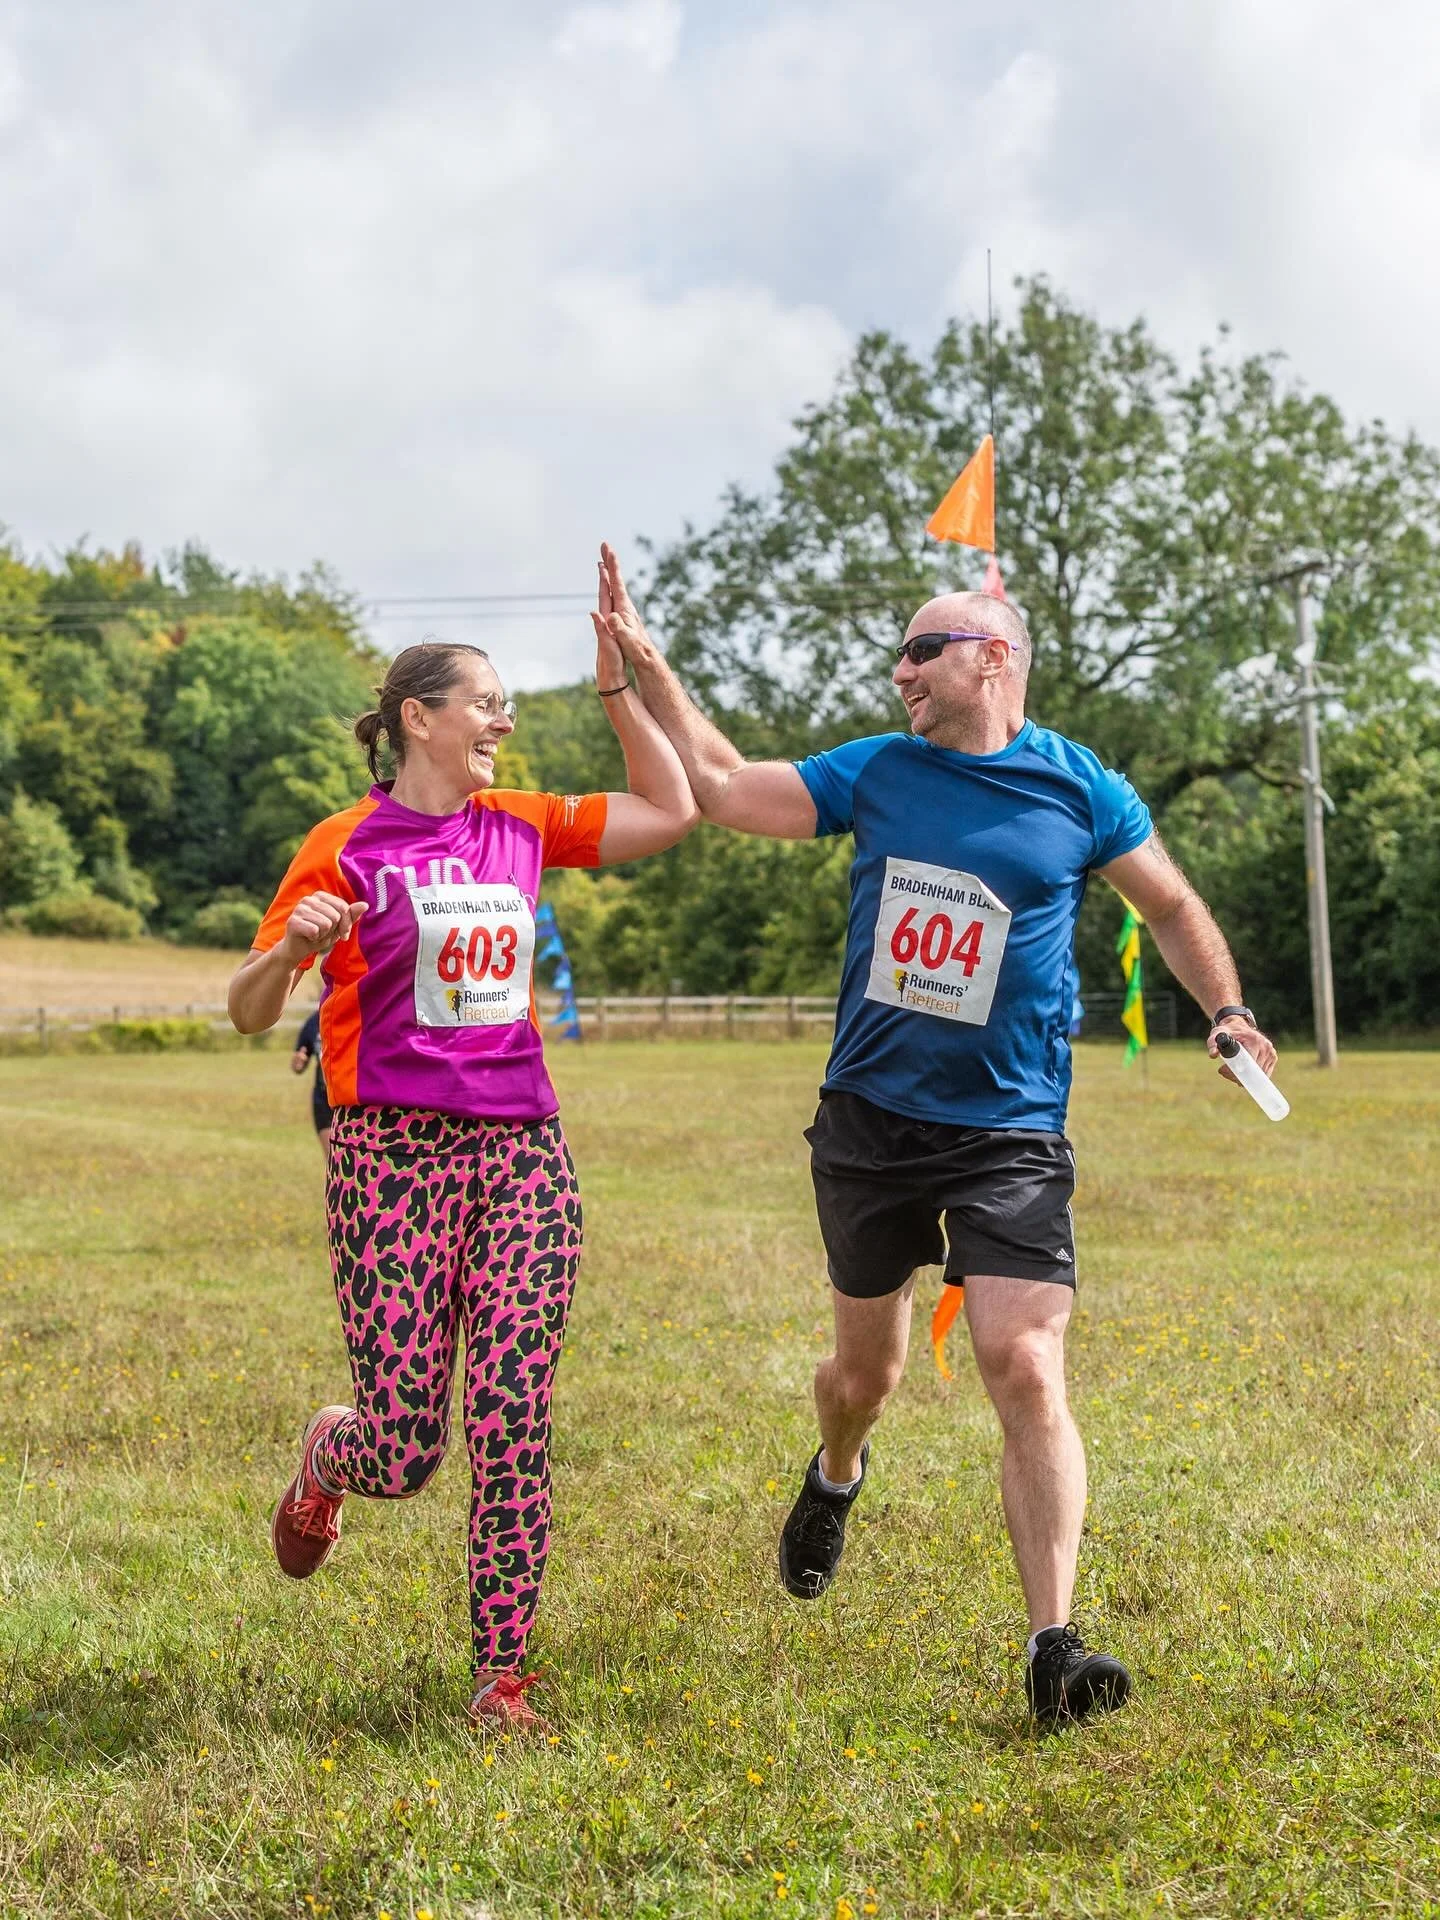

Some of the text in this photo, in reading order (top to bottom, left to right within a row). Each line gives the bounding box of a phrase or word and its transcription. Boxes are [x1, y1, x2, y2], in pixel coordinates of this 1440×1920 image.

[890, 876, 995, 910] BRADENHAM BLA
[422, 899, 524, 915] BRADENHAM BLAST
[437, 925, 518, 982] 603
[890, 907, 985, 978] 604
[464, 988, 510, 1004] Runners'
[910, 974, 969, 998] Runners'
[464, 1004, 510, 1021] Retreat
[906, 990, 961, 1014] Retreat
